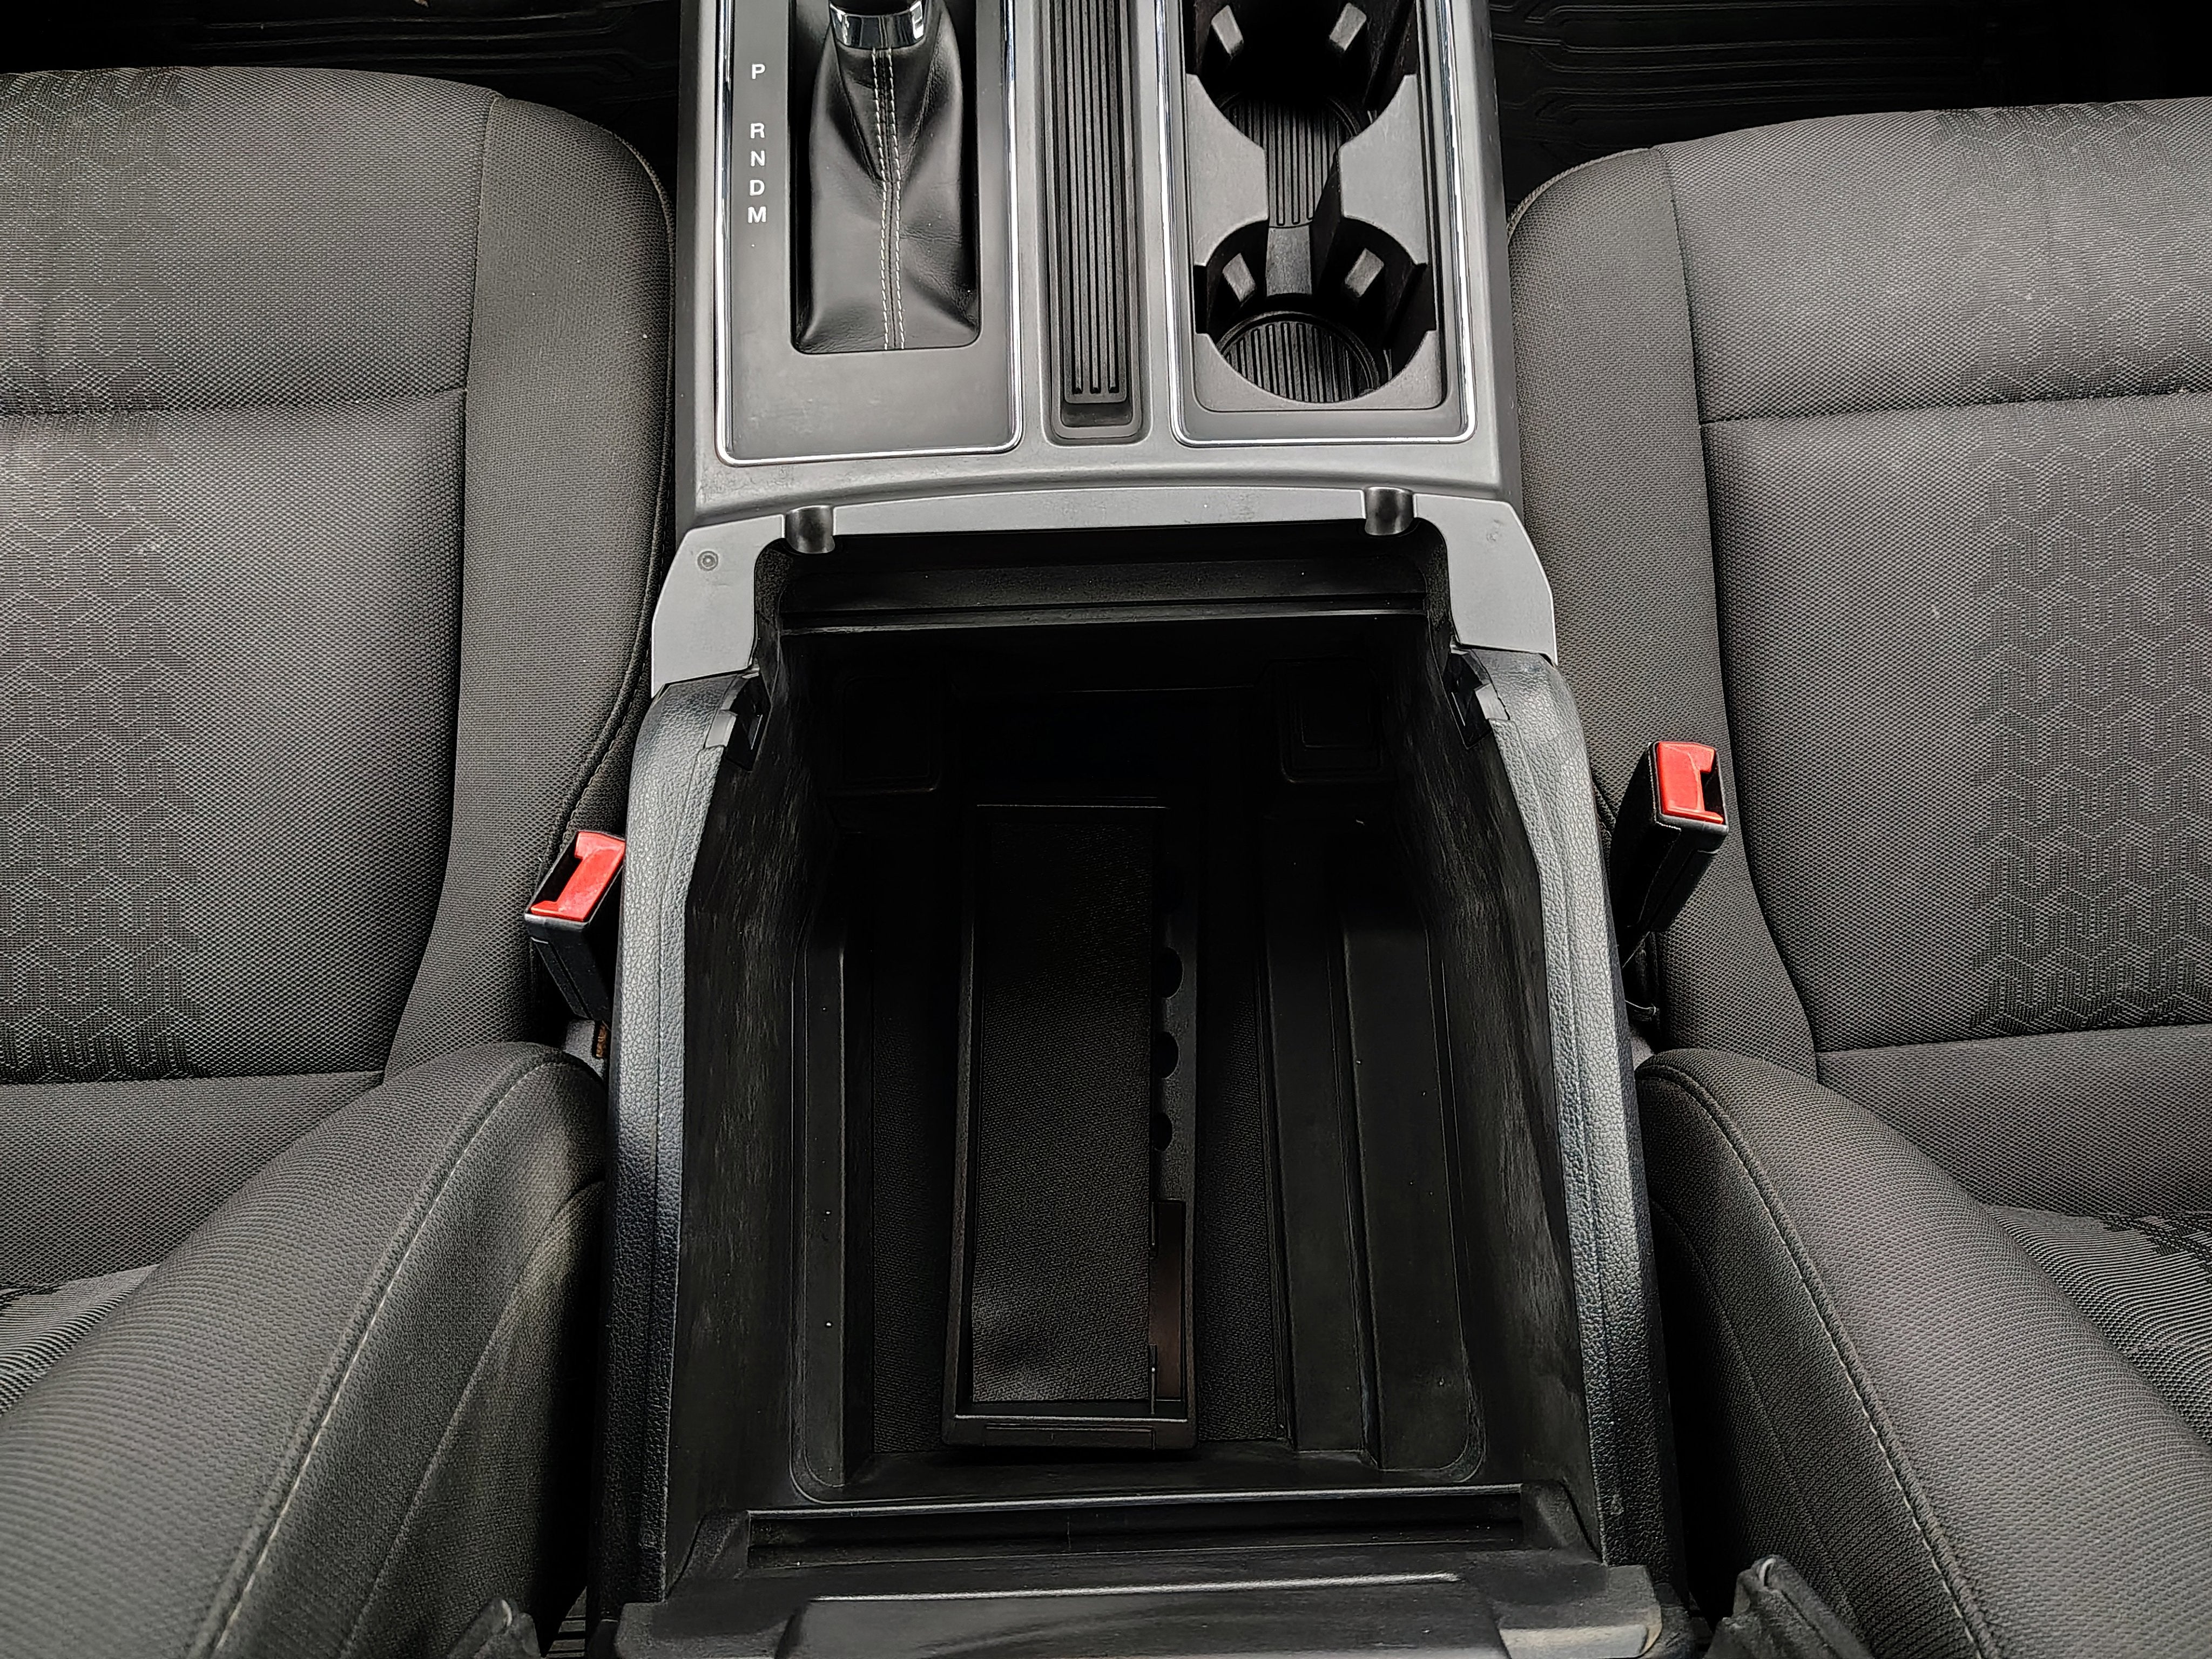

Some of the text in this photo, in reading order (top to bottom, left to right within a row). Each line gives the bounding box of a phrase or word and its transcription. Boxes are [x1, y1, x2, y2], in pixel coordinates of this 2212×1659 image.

[751, 64, 765, 79] P
[750, 122, 765, 139] R
[750, 150, 765, 167] N
[749, 179, 765, 196] D
[747, 206, 767, 224] M
